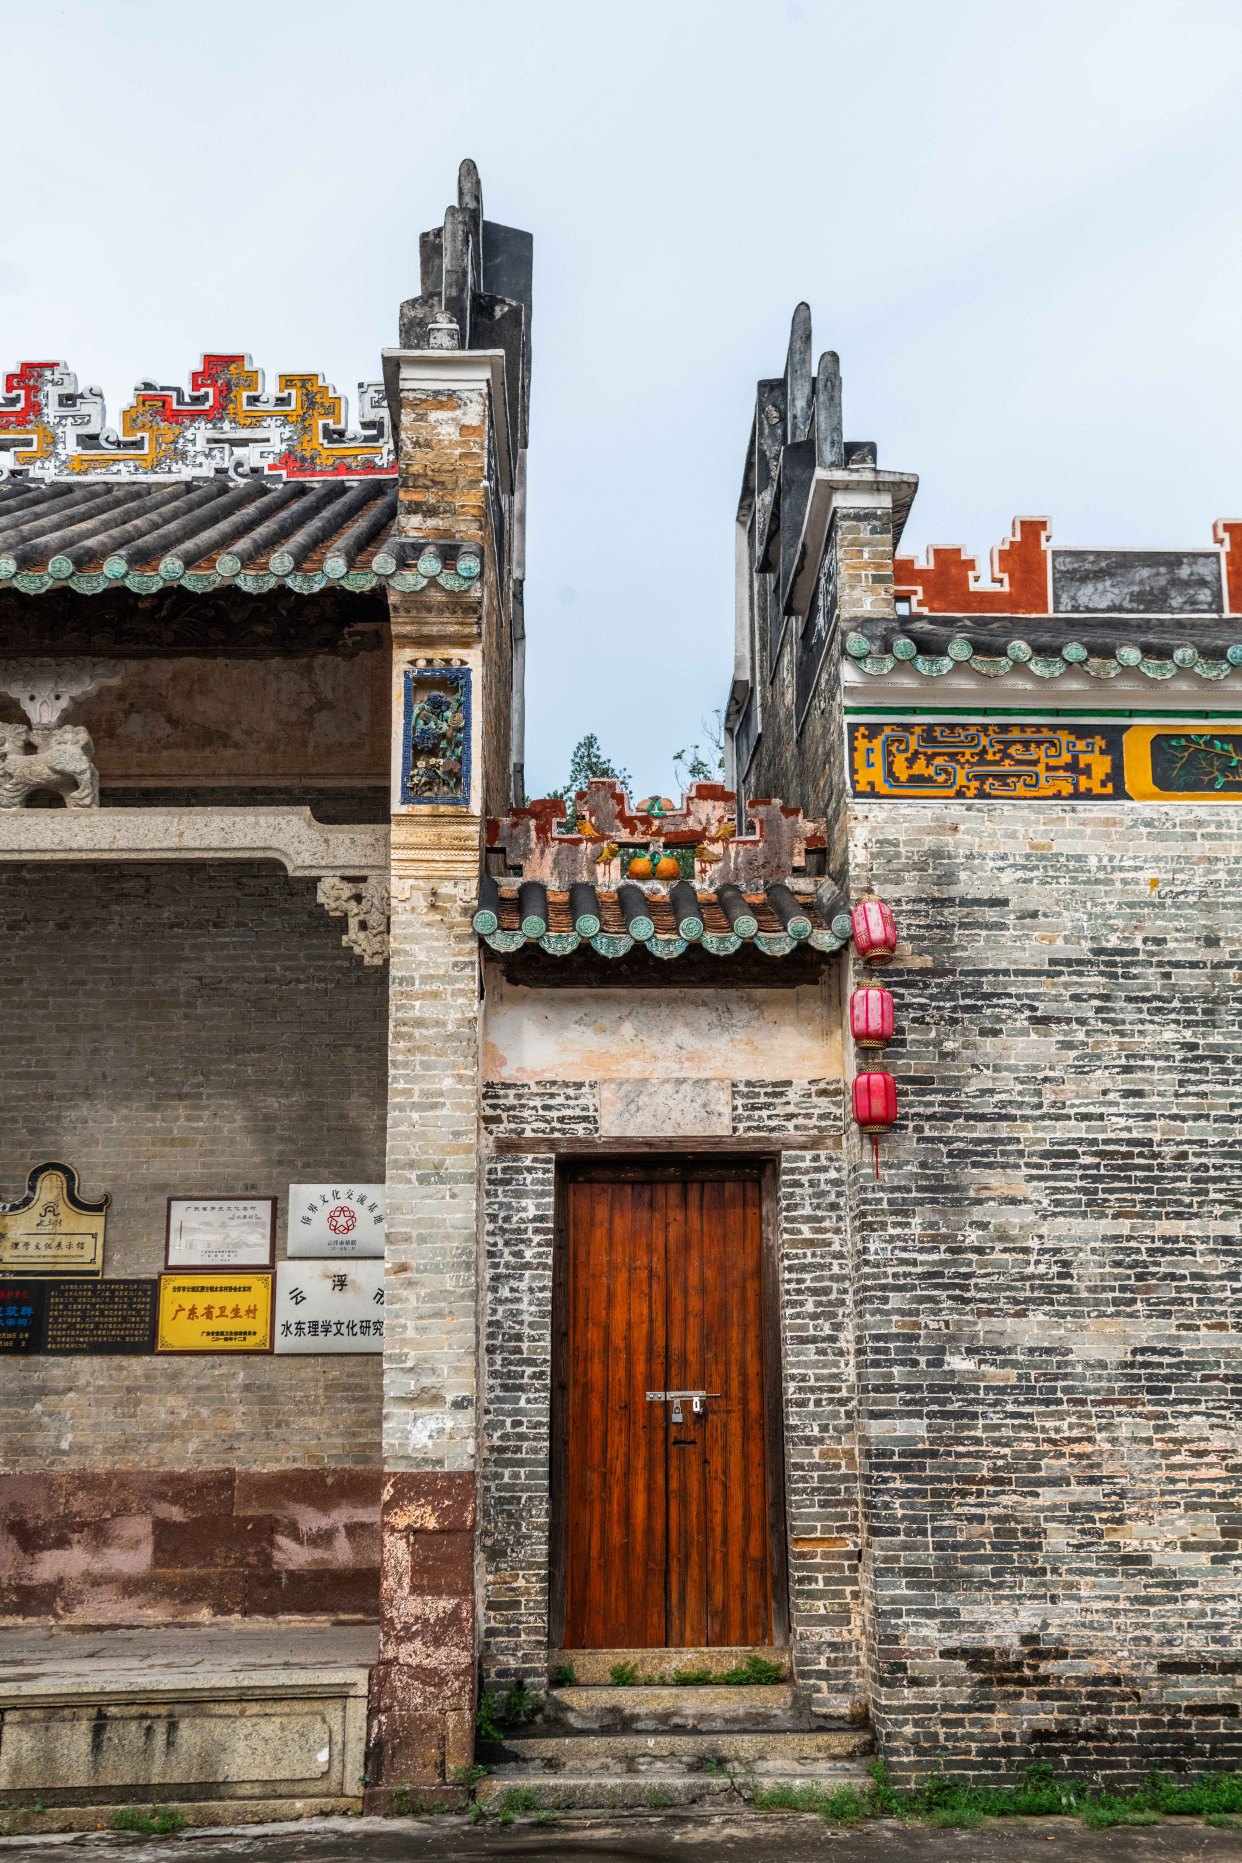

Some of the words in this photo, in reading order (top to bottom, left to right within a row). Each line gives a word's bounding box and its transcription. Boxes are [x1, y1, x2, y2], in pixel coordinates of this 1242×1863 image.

[300, 1188, 385, 1226] 侨界文化交流基地
[9, 1241, 86, 1251] 理学文化展示馆
[170, 1303, 259, 1321] 广东省卫生村
[280, 1319, 384, 1338] 水东理学文化研究
